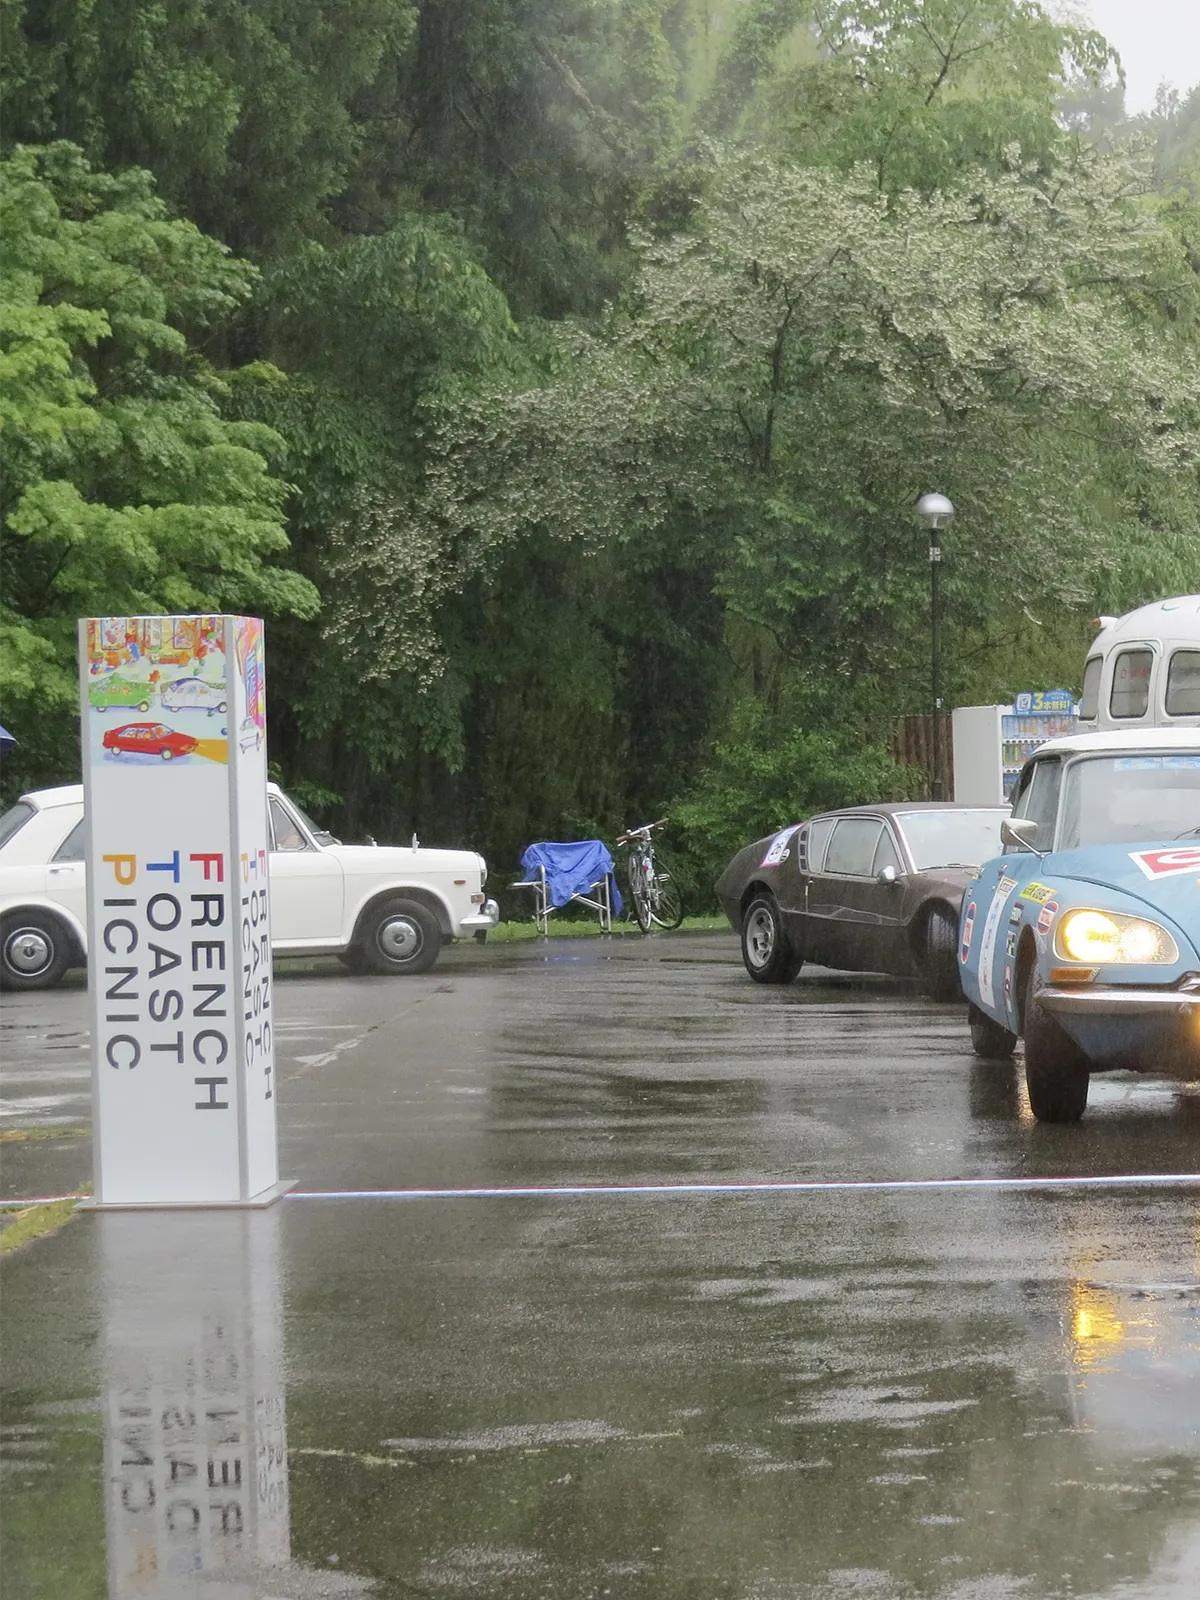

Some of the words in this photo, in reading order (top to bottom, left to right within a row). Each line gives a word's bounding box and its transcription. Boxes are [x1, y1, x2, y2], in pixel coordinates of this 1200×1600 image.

[102, 854, 141, 1070] PICNIC
[146, 850, 184, 1064] TOAST
[190, 853, 229, 1110] FRENCH
[241, 853, 254, 1068] PICNIC
[250, 848, 262, 1056] TOAST
[258, 850, 272, 1100] FRENCH
